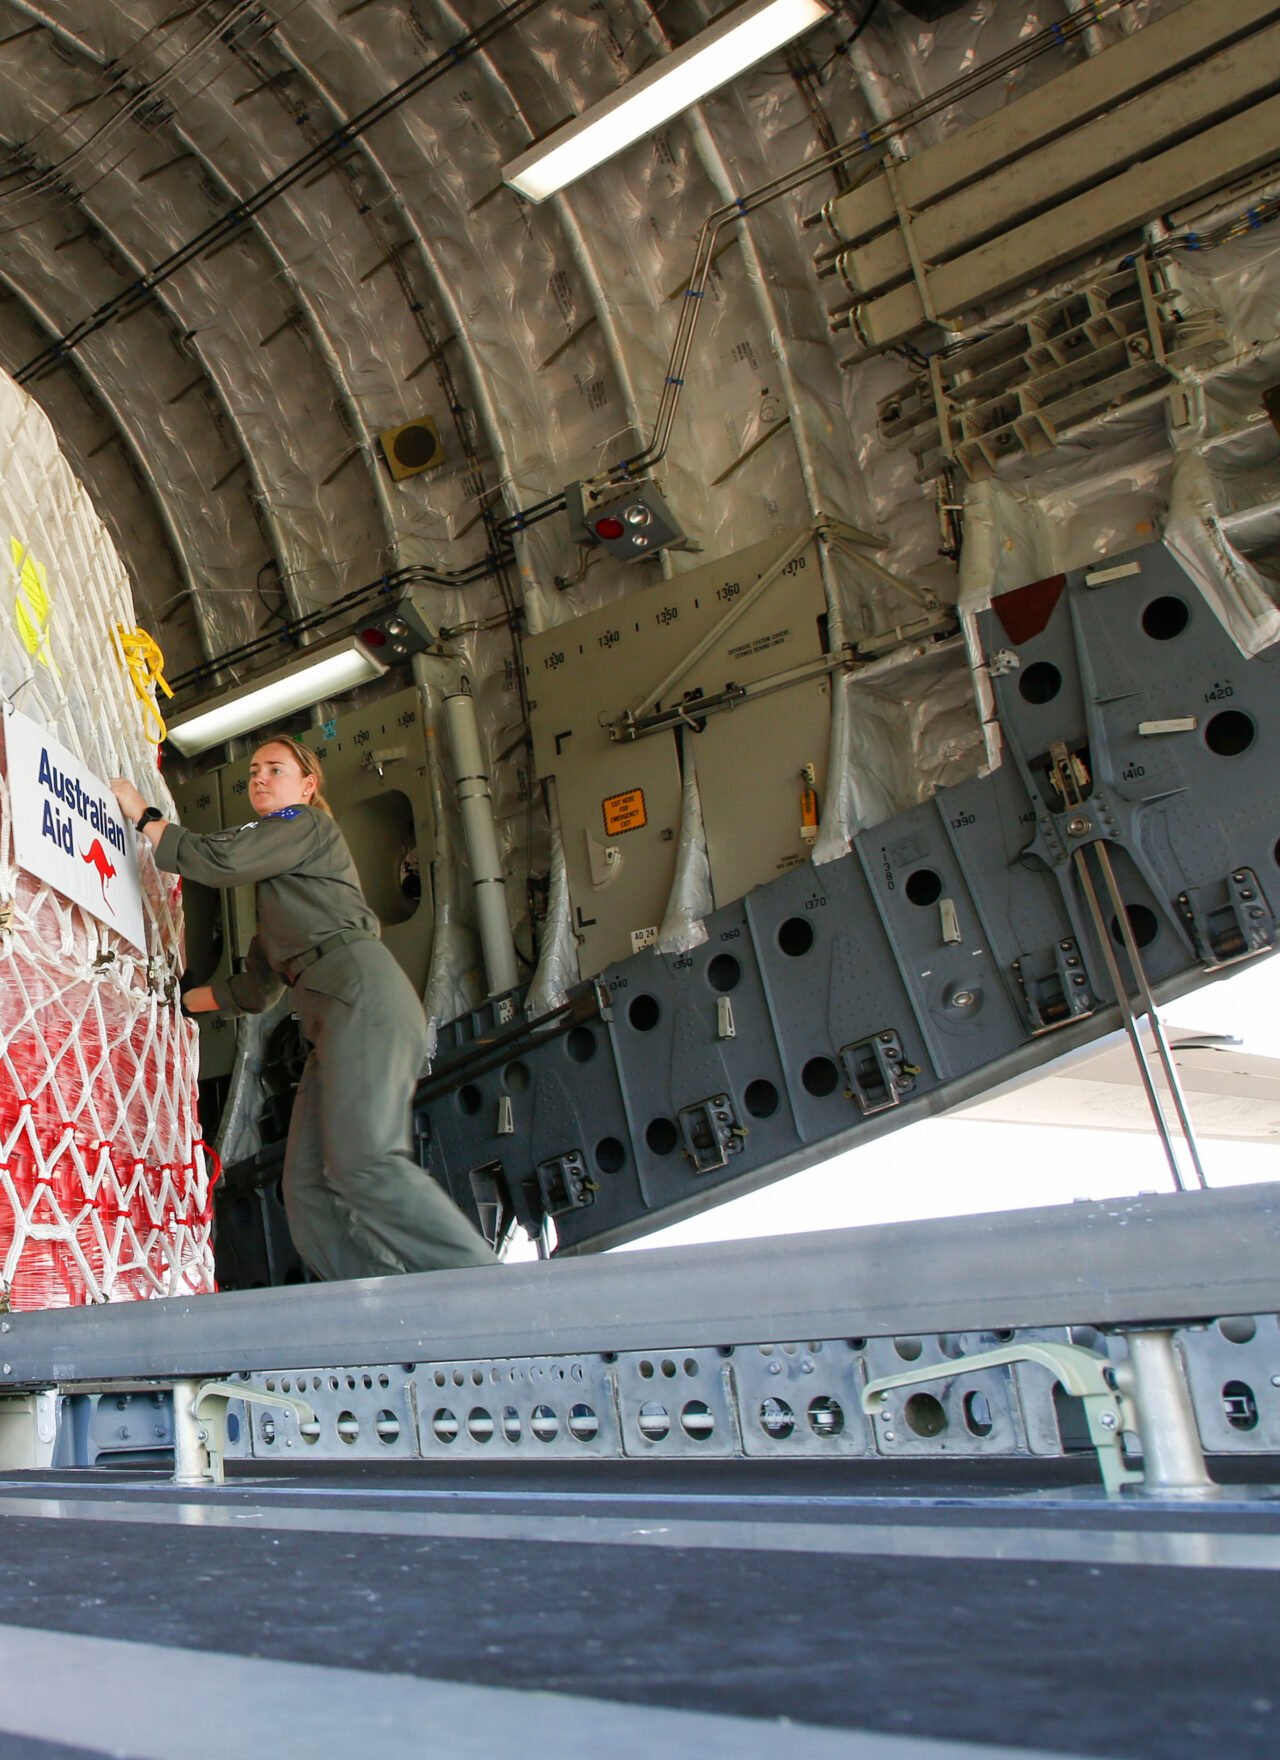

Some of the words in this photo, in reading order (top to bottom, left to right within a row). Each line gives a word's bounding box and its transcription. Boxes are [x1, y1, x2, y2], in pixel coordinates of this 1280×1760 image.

[716, 583, 740, 601] 1360
[656, 607, 678, 625] 1350
[598, 631, 620, 648] 1340
[544, 652, 565, 669] 1330
[1204, 686, 1233, 704] 1420
[1122, 766, 1145, 781] 1410
[38, 747, 126, 857] Australian
[951, 814, 976, 830] 1390
[1018, 811, 1037, 825] 140
[42, 799, 74, 858] Aid
[882, 853, 895, 890] 1380
[805, 897, 827, 911] 1370
[720, 928, 740, 943] 1360
[673, 957, 693, 970] 1350
[610, 979, 628, 991] 1340
